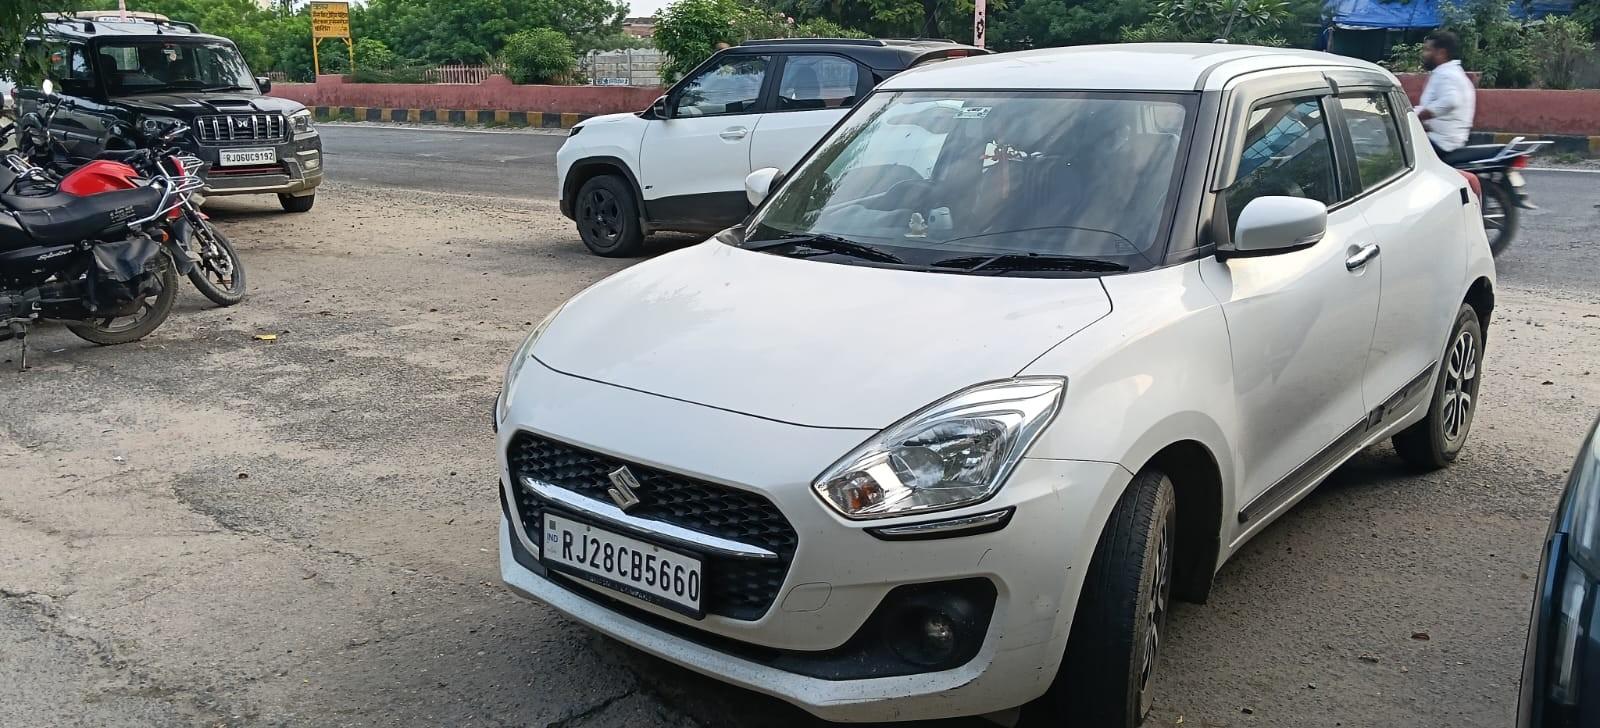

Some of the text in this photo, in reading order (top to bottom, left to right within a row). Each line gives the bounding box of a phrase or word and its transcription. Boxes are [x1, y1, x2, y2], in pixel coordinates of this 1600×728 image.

[226, 152, 273, 162] RJ06UC9192
[546, 532, 559, 543] IND
[562, 531, 700, 602] RJ28CB5660
